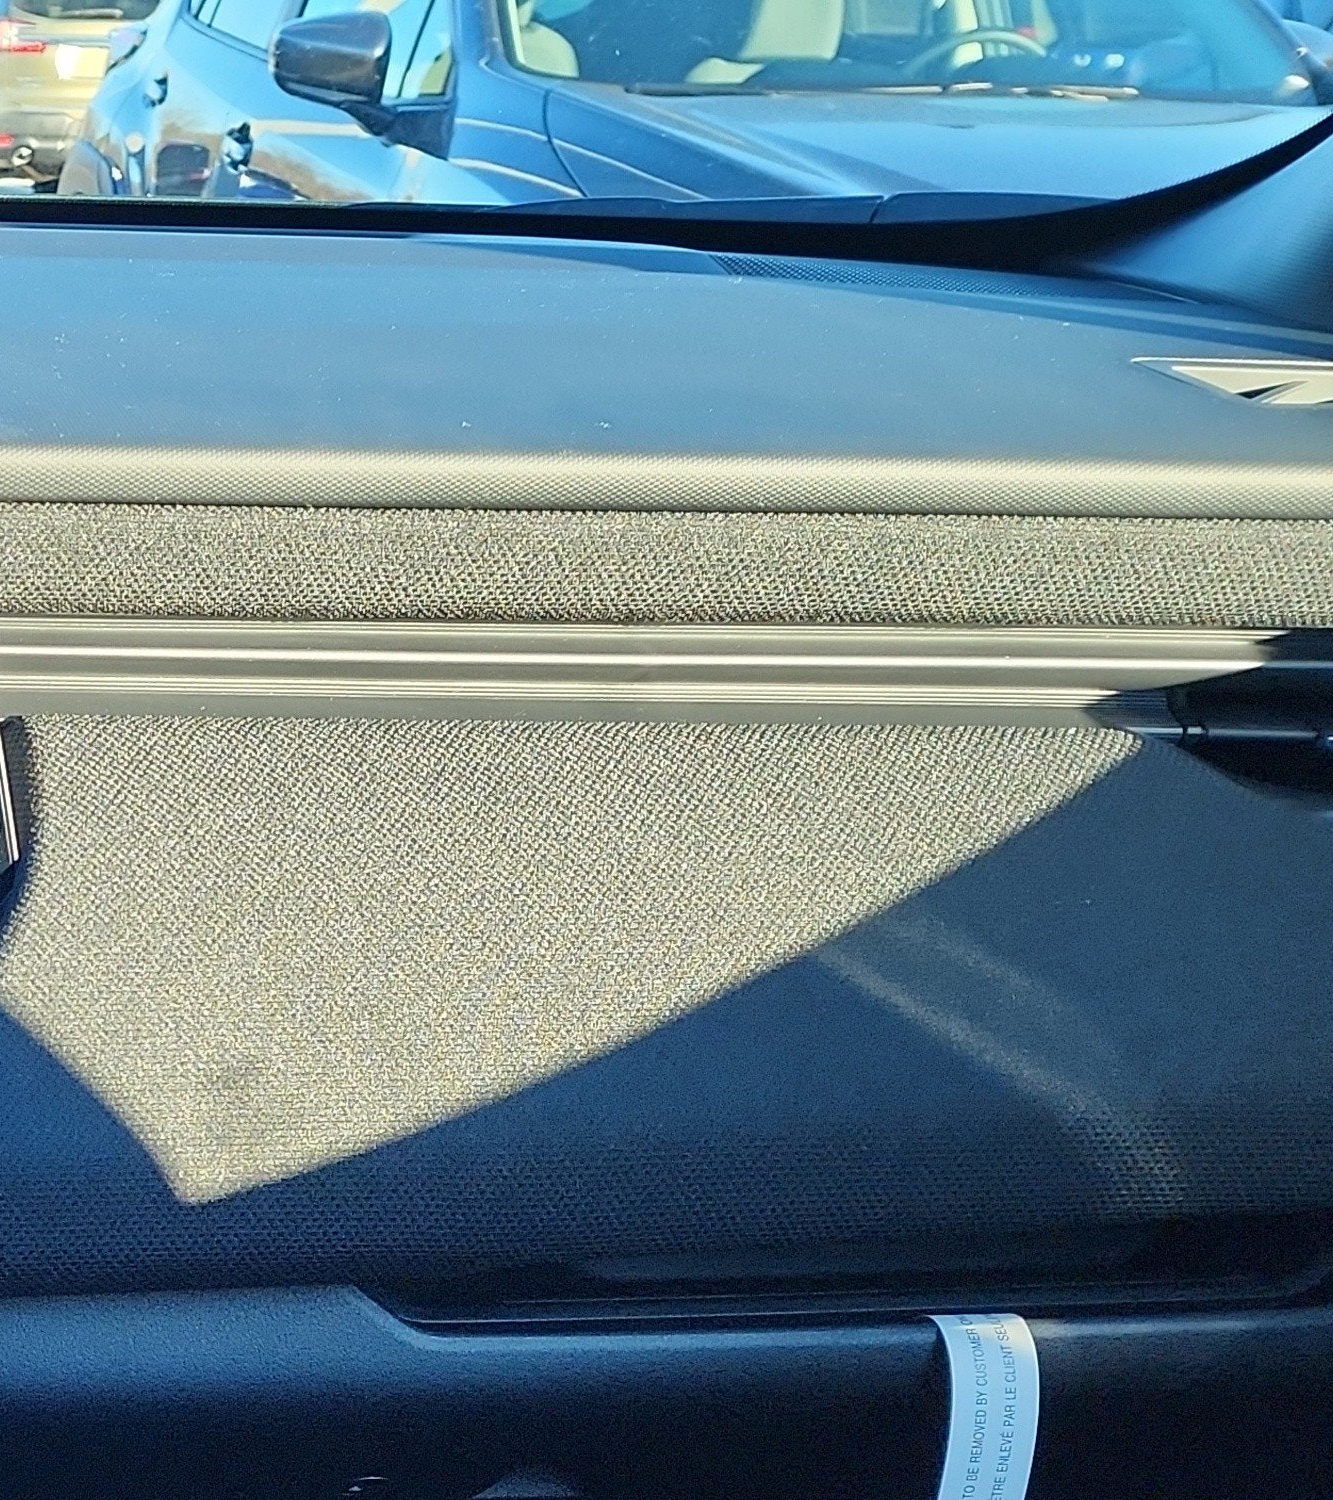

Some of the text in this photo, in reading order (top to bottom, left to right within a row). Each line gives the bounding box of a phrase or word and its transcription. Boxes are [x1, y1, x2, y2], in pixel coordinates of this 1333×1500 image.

[1000, 1345, 1016, 1382] CLIENT
[1005, 1388, 1016, 1400] LE
[962, 1328, 987, 1499] TO BE REMOVED BY CUSTOMER
[1004, 1404, 1016, 1427] PAR
